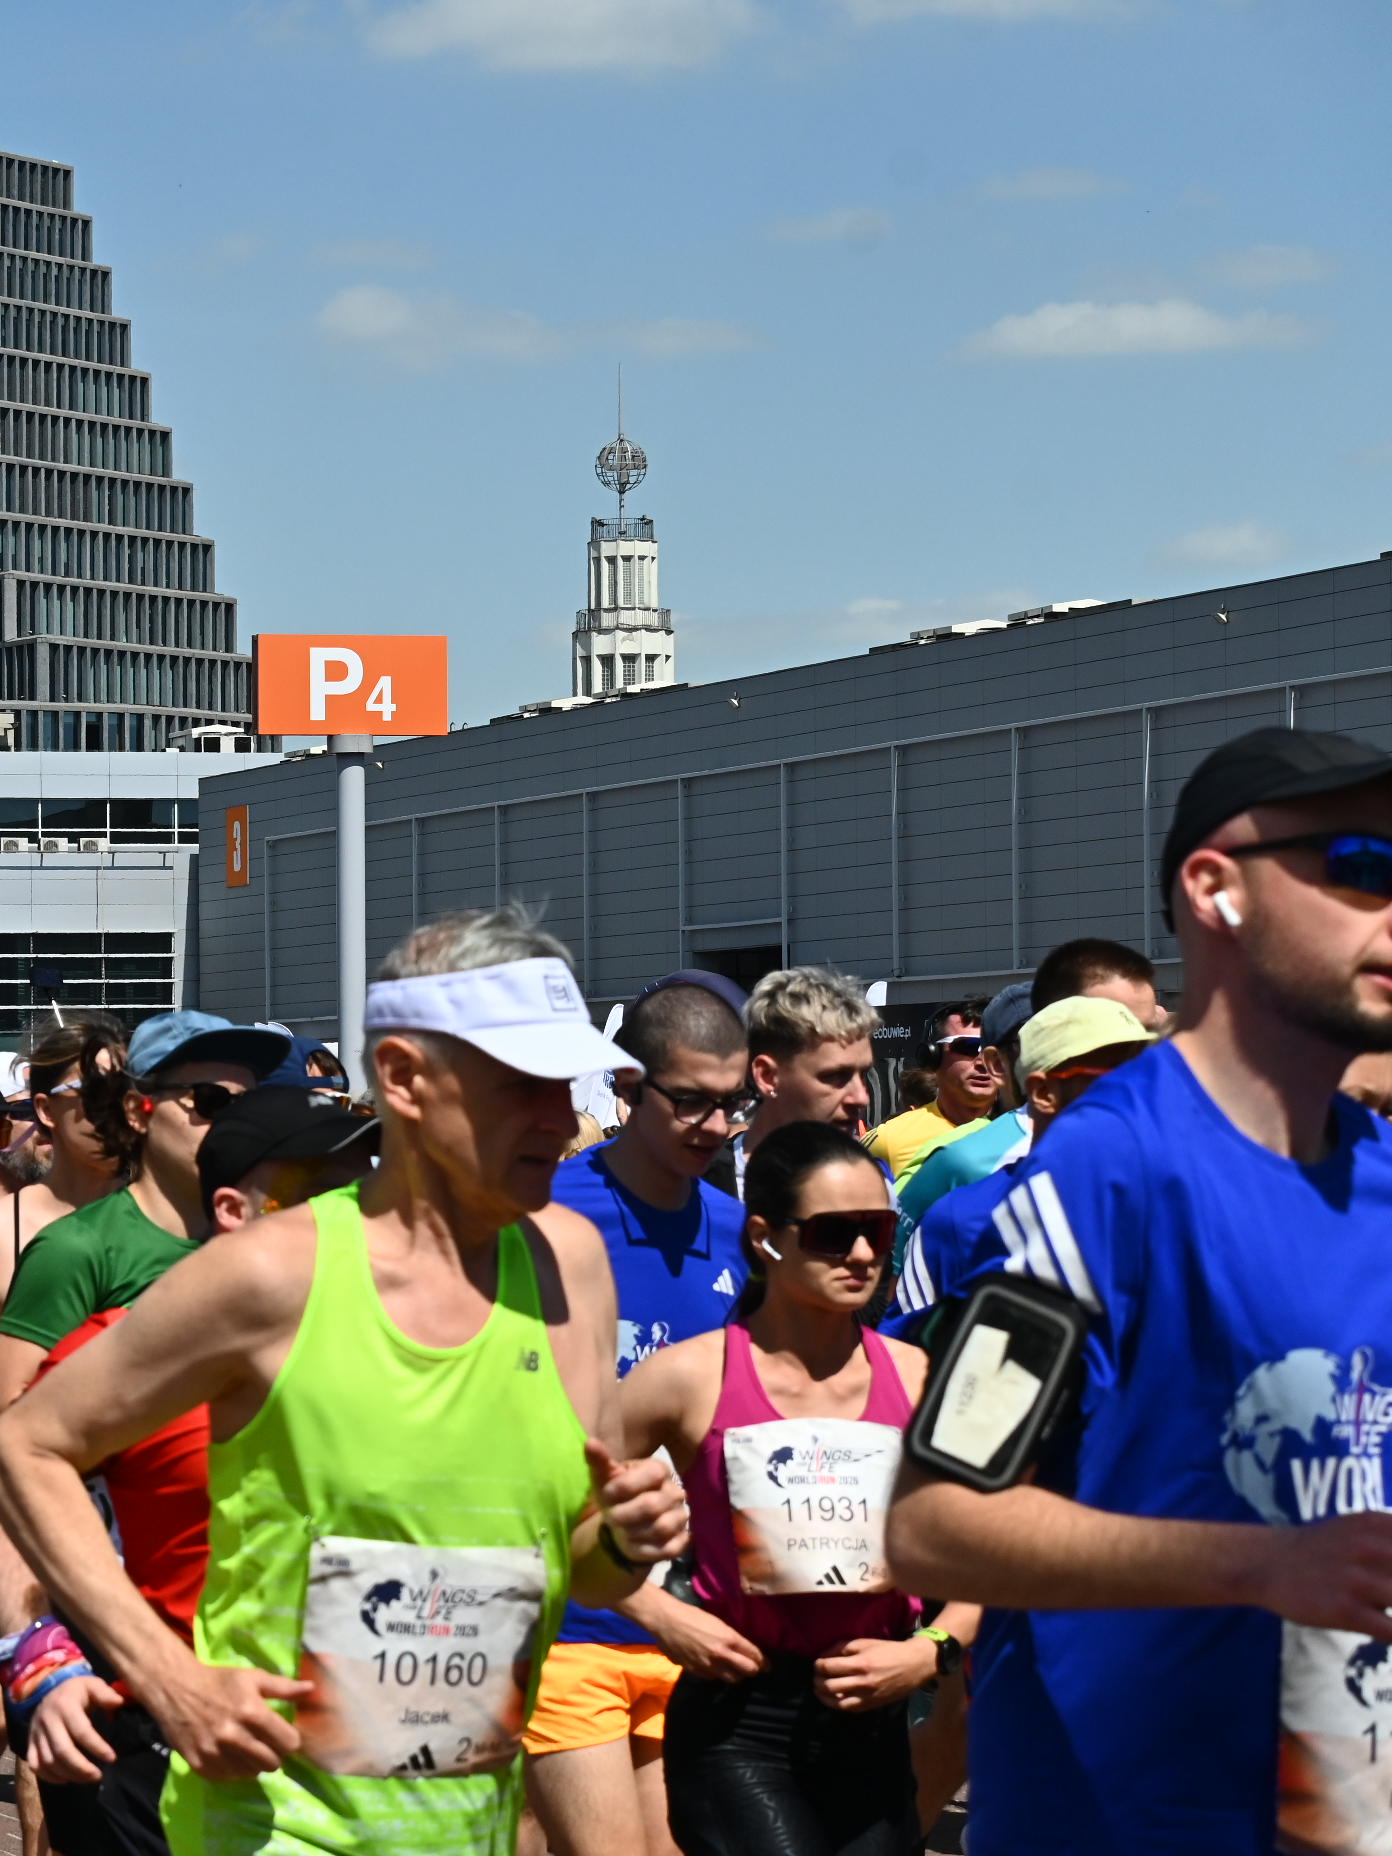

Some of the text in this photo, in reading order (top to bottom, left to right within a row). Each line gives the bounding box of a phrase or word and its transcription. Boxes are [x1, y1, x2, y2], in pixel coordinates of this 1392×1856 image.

[233, 820, 241, 872] 3
[781, 1496, 868, 1523] 11931
[787, 1537, 868, 1551] PATRYCJA
[858, 1561, 869, 1582] 2
[409, 1586, 478, 1605] WINGS
[373, 1649, 488, 1687] 10160
[398, 1707, 451, 1726] Jacek
[455, 1736, 471, 1764] 2
